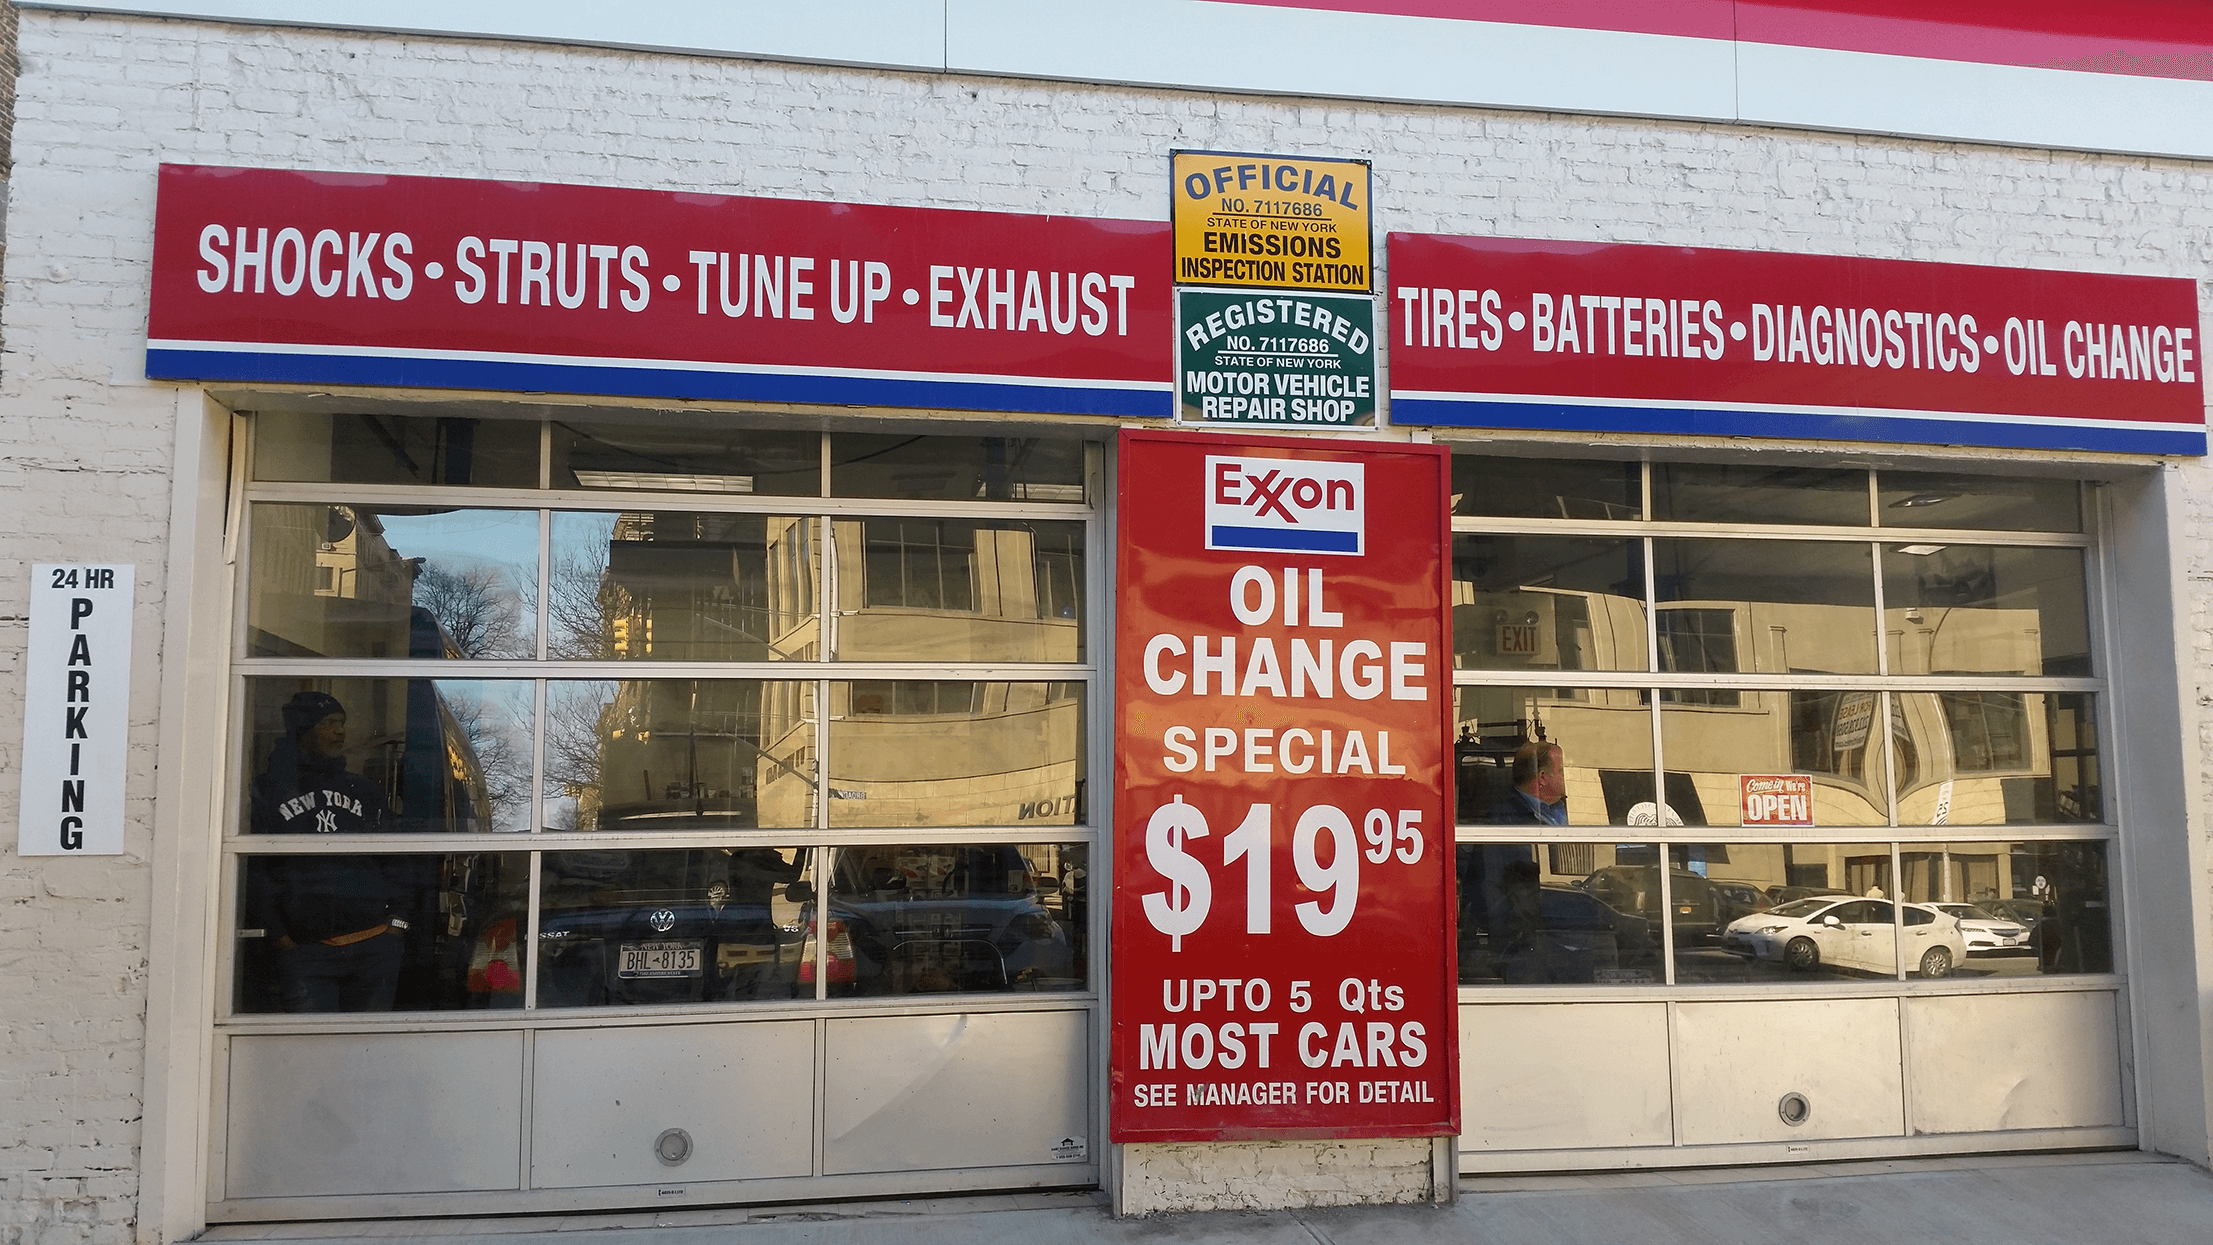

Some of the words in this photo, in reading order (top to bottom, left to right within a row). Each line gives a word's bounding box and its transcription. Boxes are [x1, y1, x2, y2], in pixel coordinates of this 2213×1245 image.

[1185, 164, 1358, 210] OFFICIAL
[1222, 198, 1249, 213] NO.
[1254, 200, 1322, 216] 7117686
[1207, 218, 1247, 229] STATE
[1251, 220, 1267, 229] OF
[1271, 221, 1299, 231] NEW
[1302, 222, 1337, 233] YORK
[1204, 232, 1341, 259] EMISSIONS
[197, 224, 413, 300] SHOCKS
[455, 236, 649, 312] STRUTS
[690, 251, 814, 320] TUNE
[831, 259, 891, 324] UP
[931, 265, 1134, 336] EXHAUST
[1181, 257, 1285, 281] INSPECTION
[1292, 262, 1364, 285] STATION
[1185, 299, 1370, 355] REGISTERED
[1398, 287, 1502, 350] TIRES
[1533, 293, 1724, 360] BATTERIES
[1752, 304, 1979, 372] DIAGNOSTICS
[2005, 317, 2056, 375] OIL
[2064, 323, 2195, 383] CHANGE
[1227, 336, 1255, 351] NO.
[1259, 337, 1329, 353] 7117686
[1214, 356, 1254, 366] STATE
[1256, 357, 1273, 367] OF
[1276, 358, 1304, 368] NEW
[1307, 359, 1341, 369] YORK
[1187, 371, 1269, 395] MOTOR
[1274, 374, 1370, 398] VEHICLE
[1202, 396, 1286, 420] REPAIR
[1291, 399, 1356, 422] SHOP
[1215, 463, 1355, 524] Exxon
[52, 568, 78, 588] 24
[85, 568, 114, 588] HR
[1230, 565, 1344, 628] OIL
[1503, 626, 1536, 651] EXIT
[1143, 633, 1428, 701] CHANGE
[60, 598, 93, 850] PARKING
[1163, 725, 1406, 775] SPECIAL
[1786, 780, 1806, 792] We're
[279, 791, 316, 821] NEW
[322, 789, 362, 817] YORK
[1747, 794, 1808, 821] OPEN
[315, 809, 338, 832] NY
[524, 930, 570, 940] SSAT
[641, 942, 660, 951] NEW
[662, 942, 683, 951] YORK
[627, 951, 651, 970] BHL
[661, 950, 695, 969] 8135
[1163, 977, 1272, 1013] UPTO
[1289, 980, 1312, 1013] 5
[1338, 977, 1405, 1015] Qts
[1139, 1022, 1279, 1070] MOST
[1298, 1021, 1428, 1069] CARS
[1134, 1083, 1177, 1108] SEE
[1186, 1081, 1297, 1106] MANAGER
[1306, 1081, 1350, 1105] FOR
[1358, 1080, 1434, 1104] DETAIL
